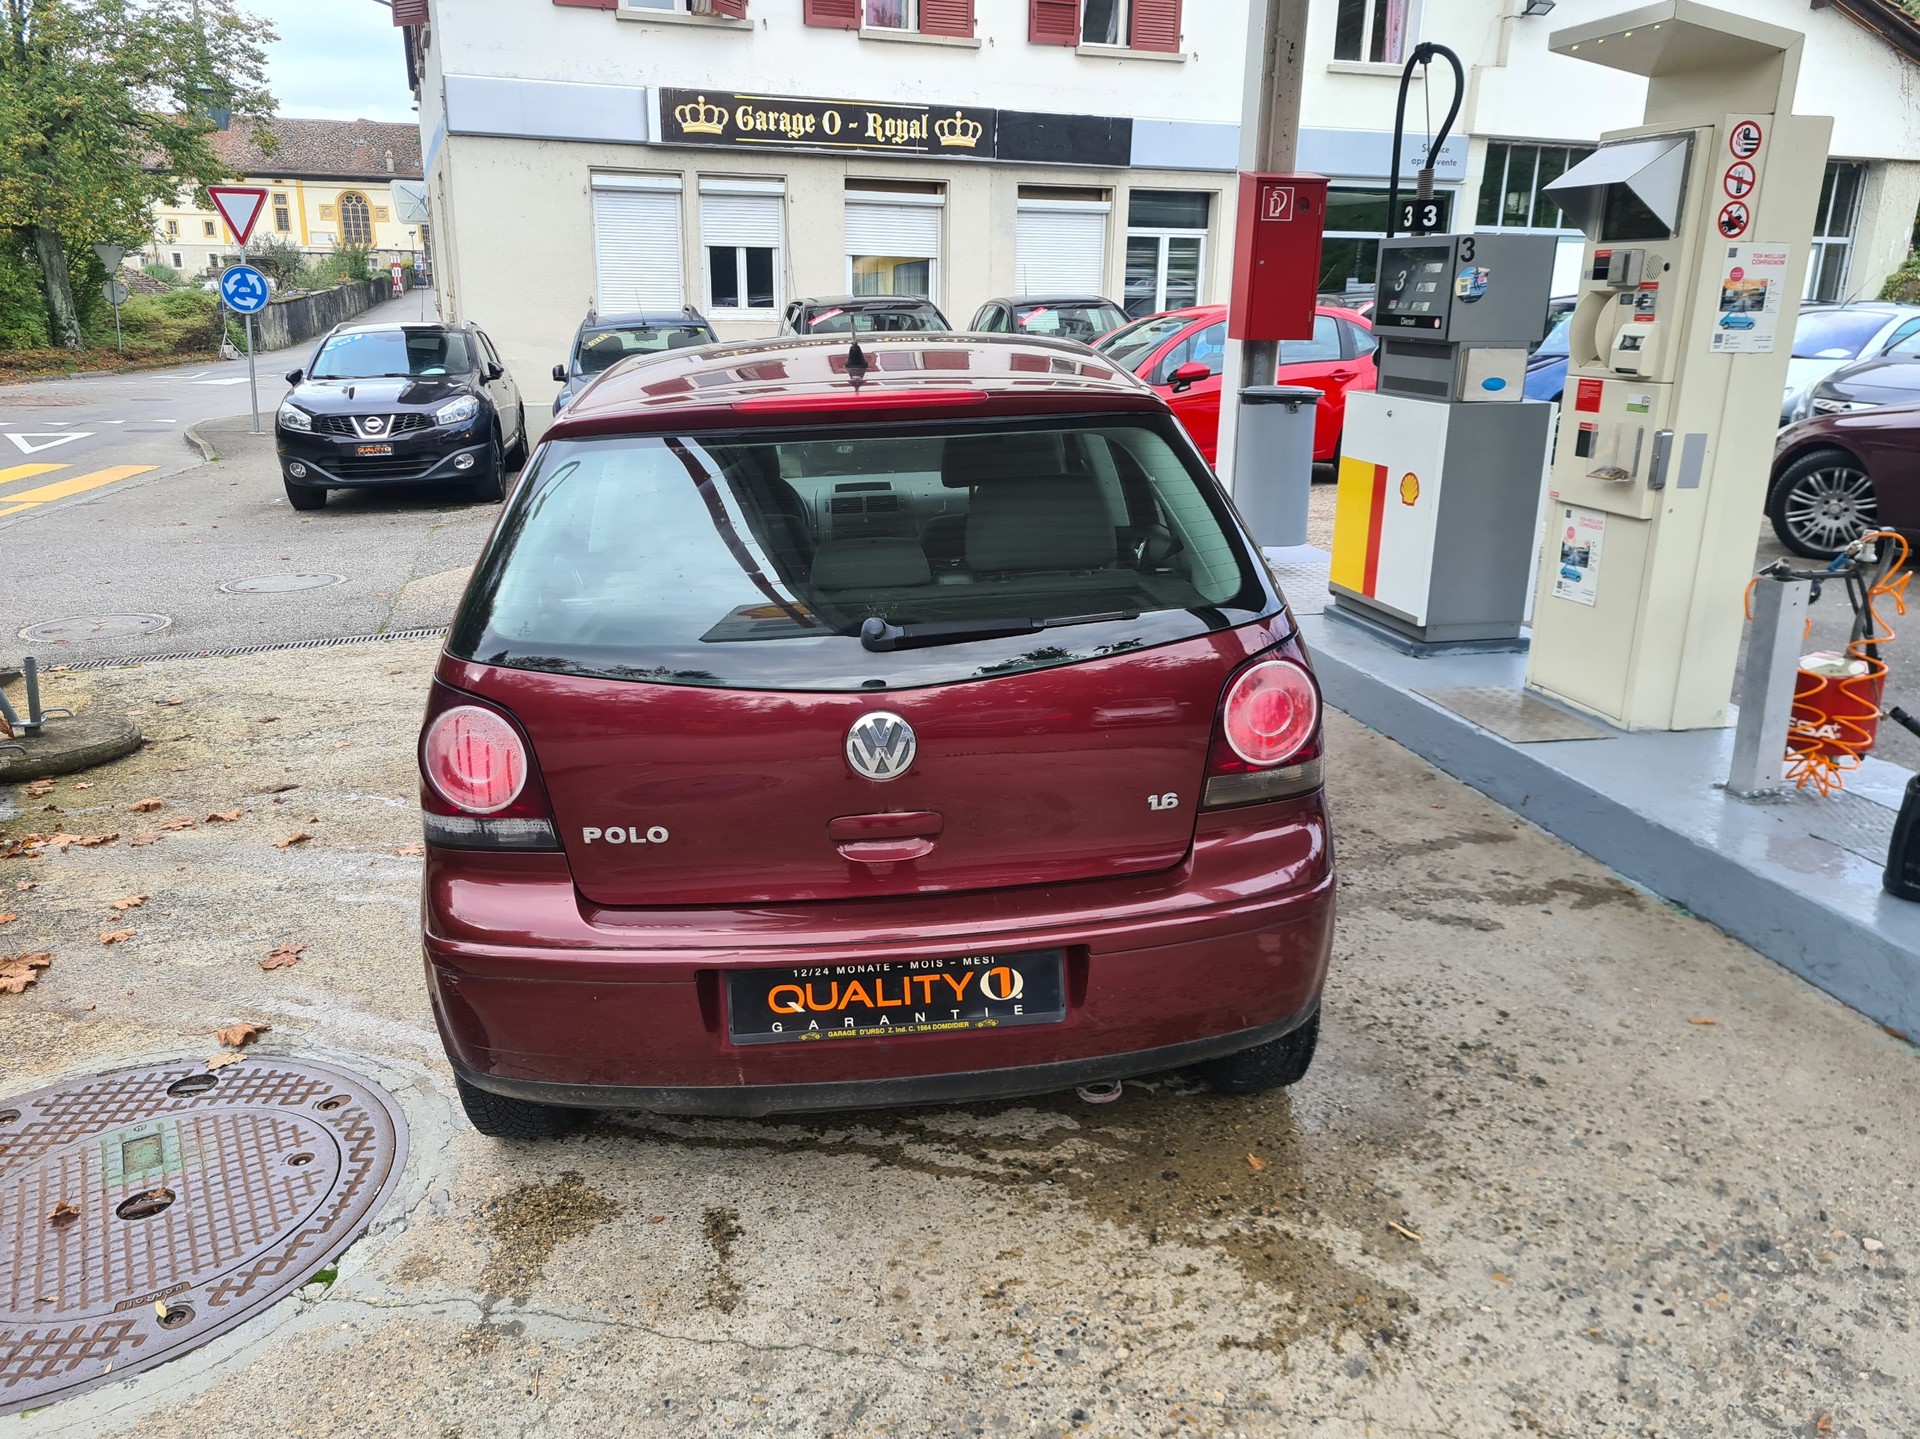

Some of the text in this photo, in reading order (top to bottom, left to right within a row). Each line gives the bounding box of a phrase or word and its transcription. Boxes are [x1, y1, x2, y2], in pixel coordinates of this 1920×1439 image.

[735, 105, 816, 139] Garage
[822, 110, 841, 136] O
[865, 111, 929, 145] Royal
[1403, 205, 1413, 228] 3
[1422, 204, 1437, 227] 3
[1460, 237, 1475, 262] 3
[1394, 270, 1407, 292] 3
[1400, 316, 1416, 326] Diesel
[582, 826, 669, 844] POLO
[793, 967, 829, 978] 12/24
[836, 963, 891, 975] MONATE
[910, 959, 943, 970] MOIS
[962, 956, 995, 966] MESI
[767, 971, 975, 1014] QUALITY
[771, 1004, 1024, 1033] GARANTIE
[828, 1029, 857, 1038] GARAGE
[860, 1027, 885, 1035] D'URSO
[932, 1021, 970, 1031] DOMDIDIER
